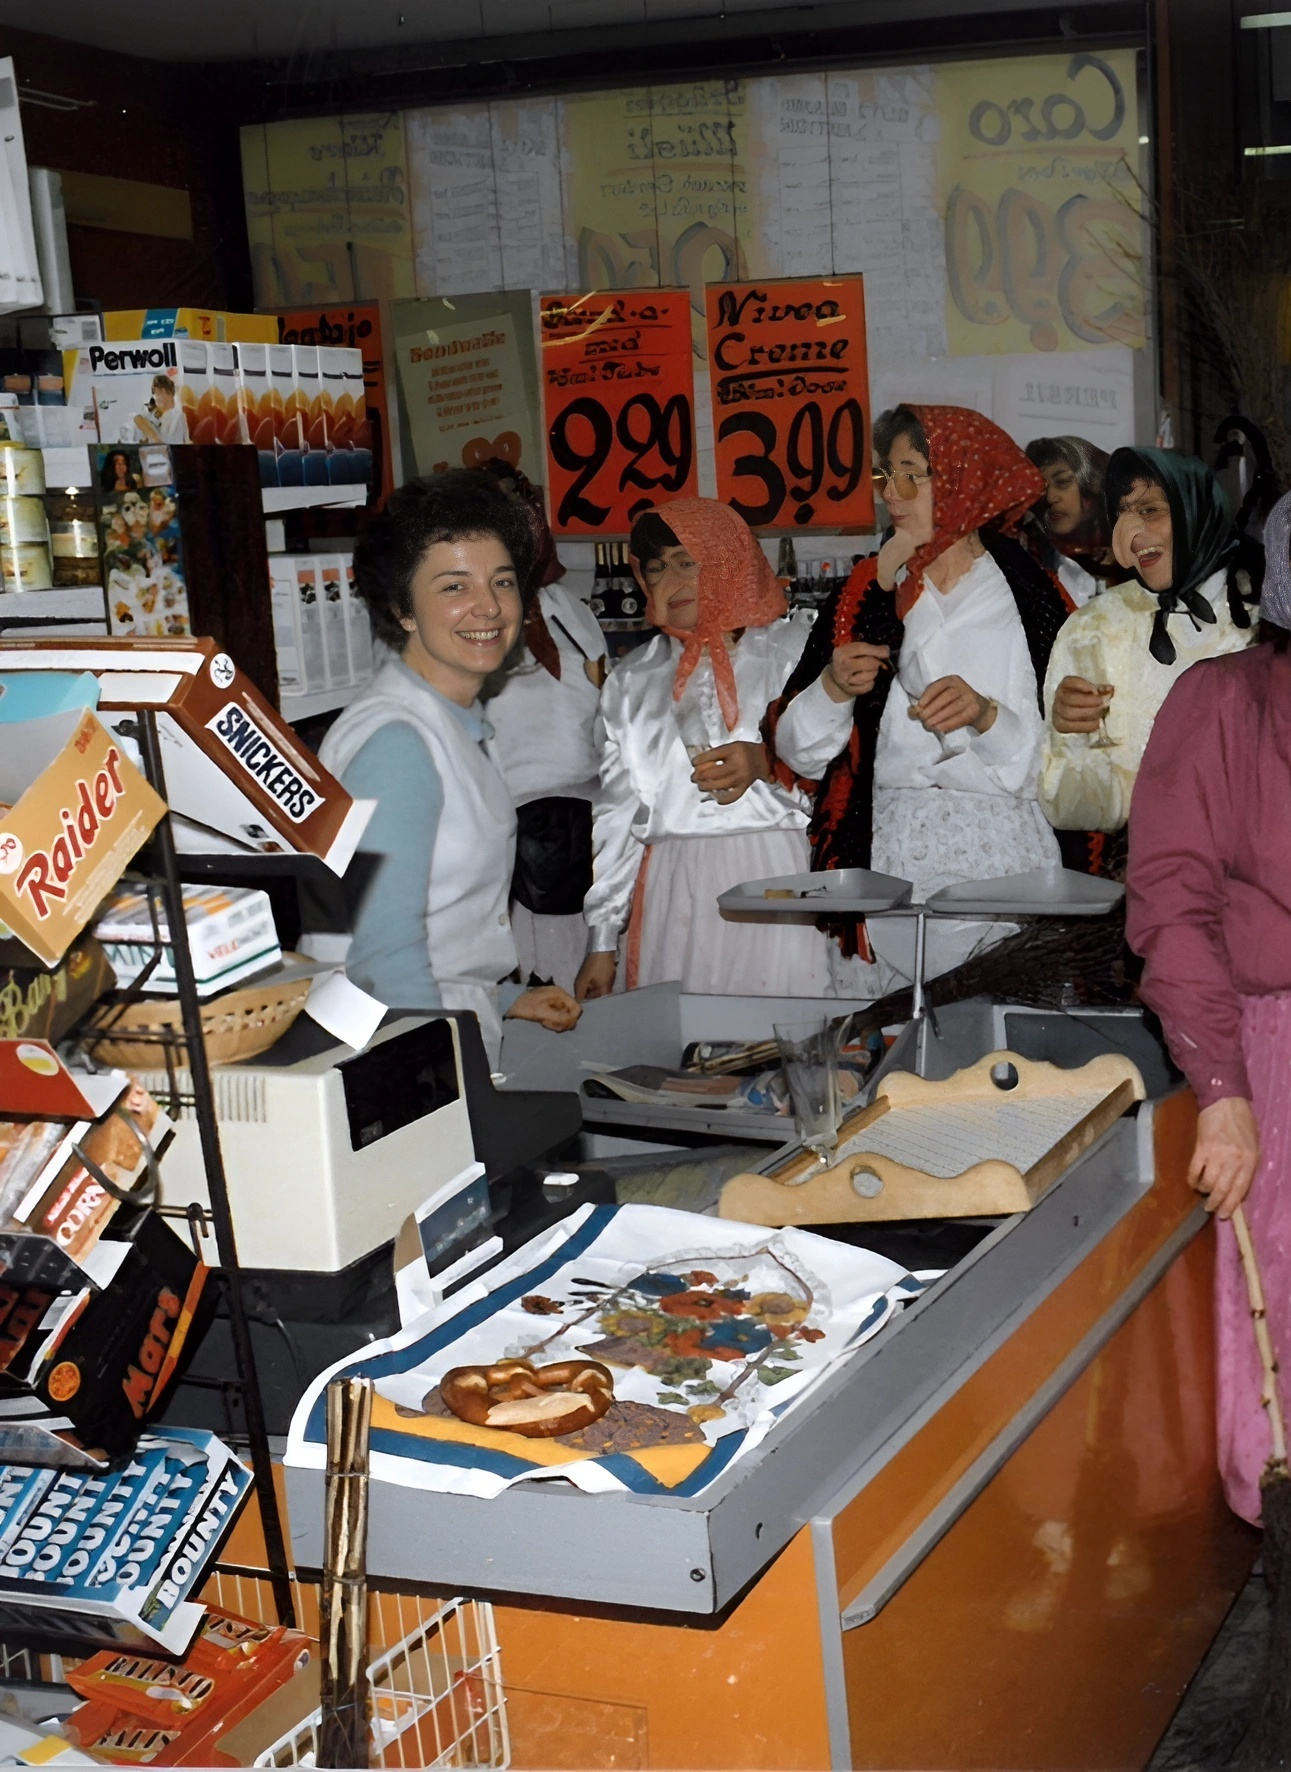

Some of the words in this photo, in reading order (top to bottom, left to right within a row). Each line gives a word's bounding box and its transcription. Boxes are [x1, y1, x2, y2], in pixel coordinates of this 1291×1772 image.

[89, 342, 179, 373] Perwoll
[714, 332, 850, 371] Creme
[717, 397, 864, 527] 3.99
[216, 706, 315, 818] SNICKERS
[15, 747, 125, 919] Raider
[115, 1472, 193, 1587] OUNTY
[156, 1470, 239, 1610] BOUNTY
